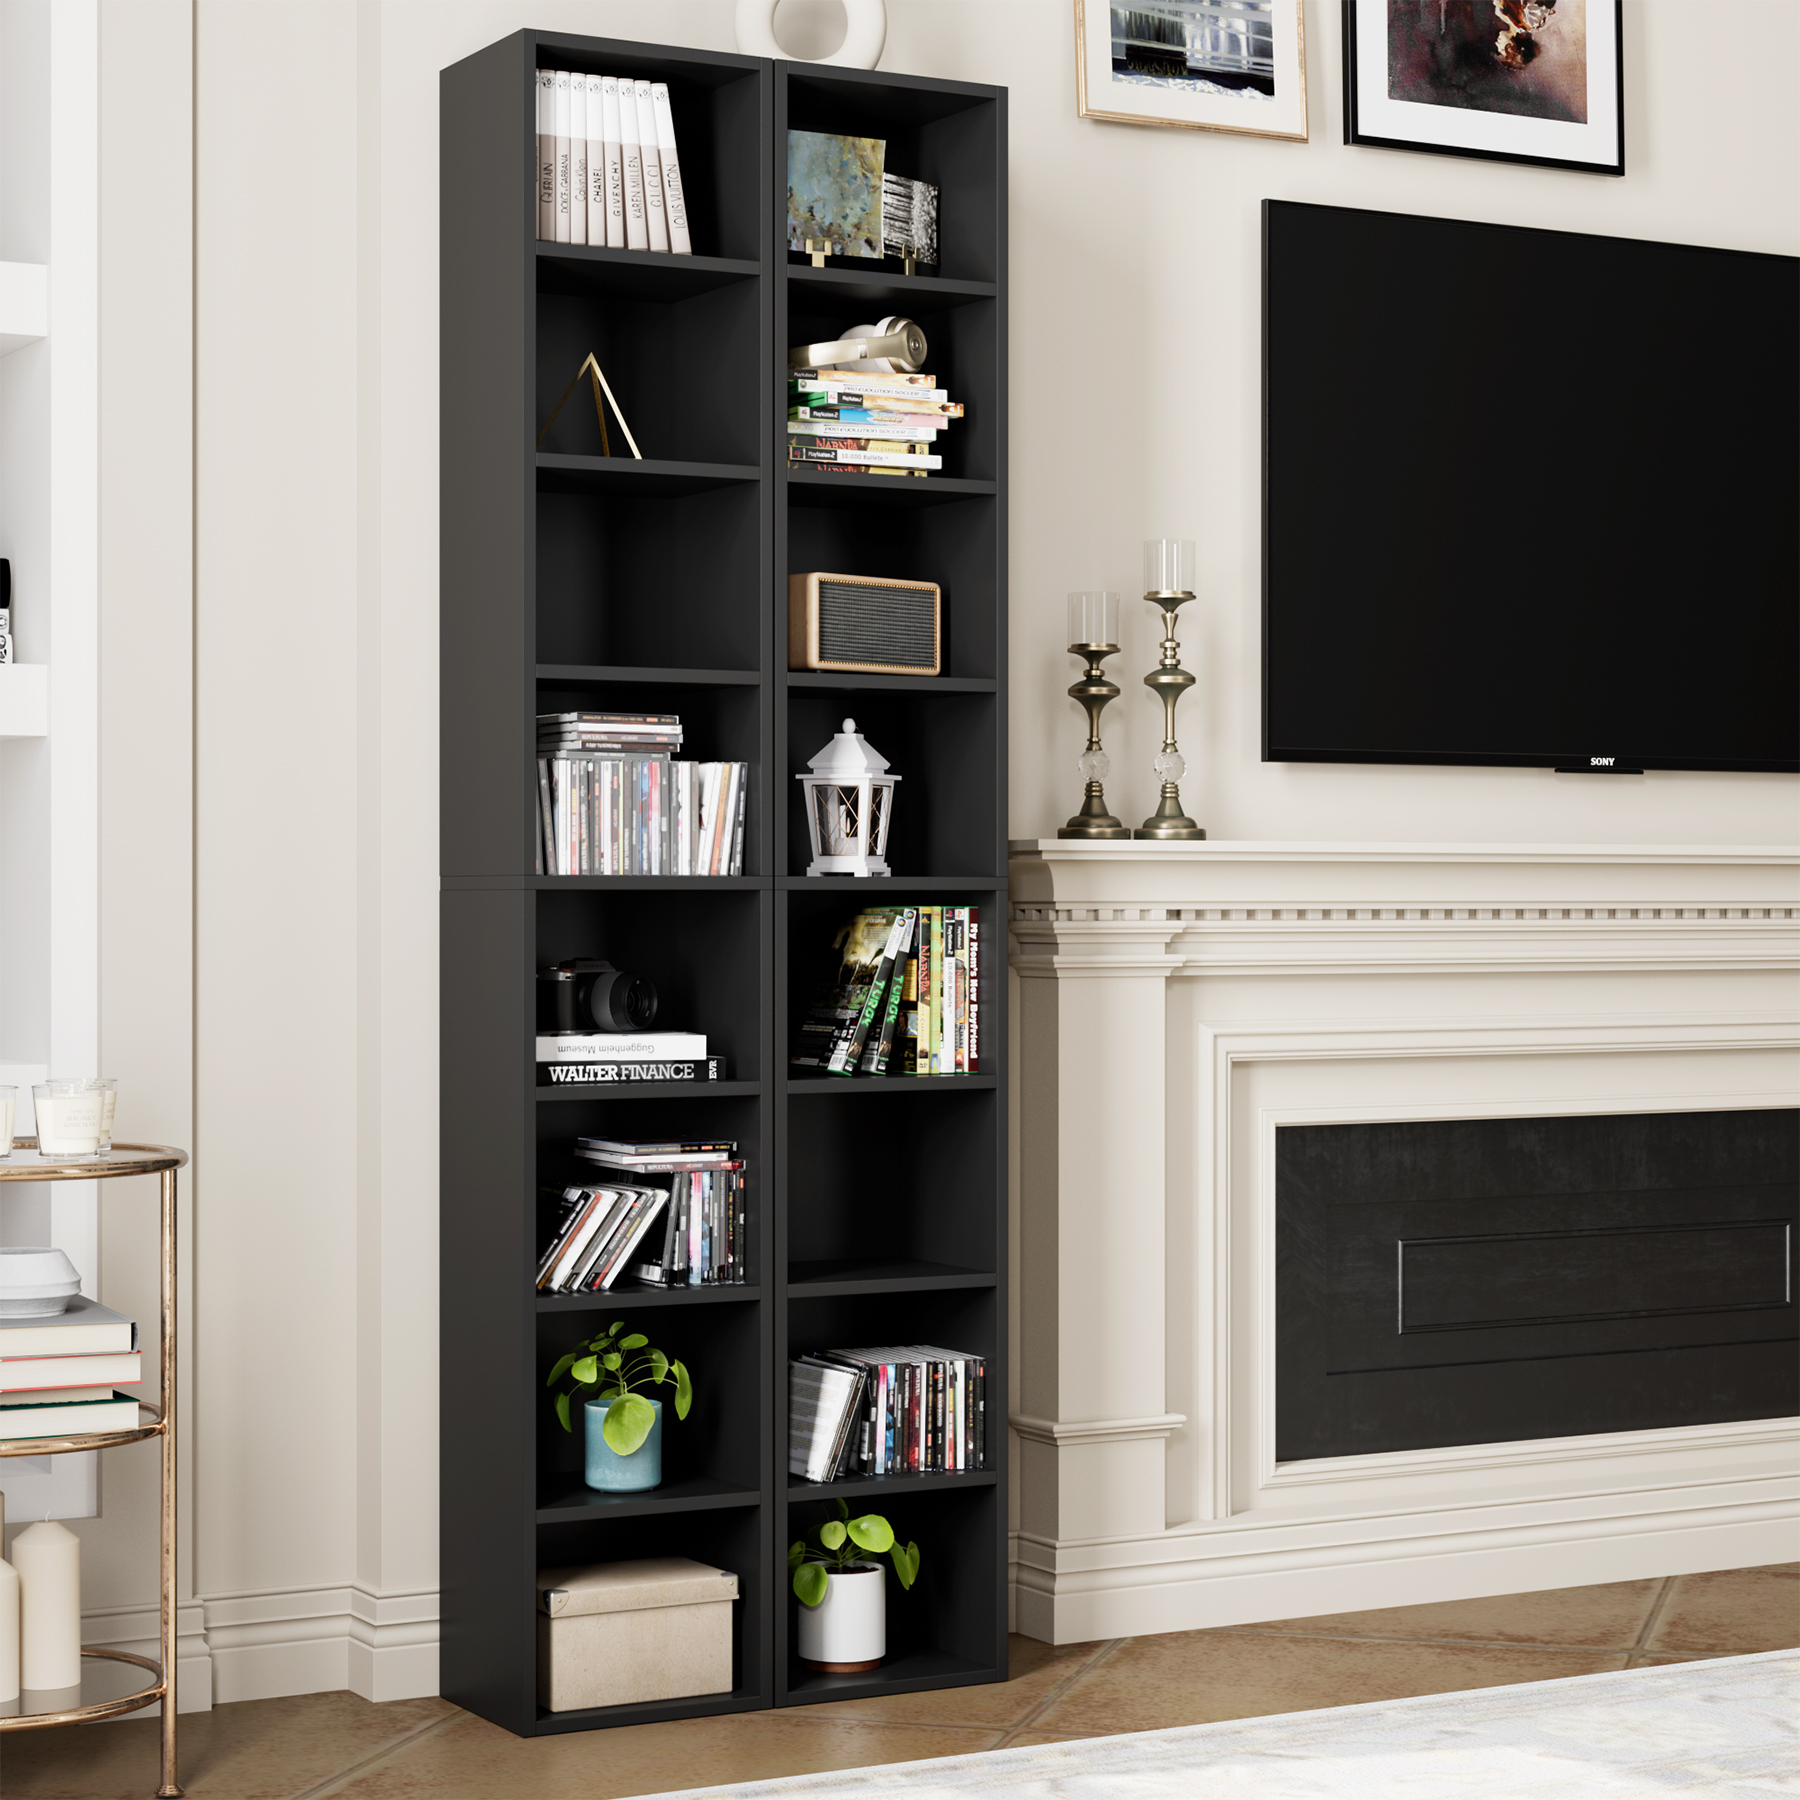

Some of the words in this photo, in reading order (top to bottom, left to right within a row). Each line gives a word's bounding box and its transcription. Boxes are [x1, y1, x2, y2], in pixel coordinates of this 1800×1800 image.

[593, 167, 602, 203] CHANEL
[628, 156, 640, 188] MILLEN
[647, 164, 662, 207] GUCCI
[666, 164, 682, 202] VUITTON
[611, 160, 621, 217] GIVENCHY
[631, 191, 643, 219] KAREN
[672, 203, 686, 229] LOUIS
[1590, 757, 1615, 766] SONY
[969, 923, 978, 941] My
[969, 942, 979, 978] Mom's
[861, 979, 886, 1028] TUROK
[886, 974, 904, 1025] TUROK
[969, 978, 979, 1002] New
[969, 1004, 979, 1059] Boyfriend
[558, 1045, 596, 1054] Museum
[598, 1043, 655, 1054] Guggenheim
[548, 1065, 619, 1082] WALTER
[620, 1063, 695, 1080] FINANCE
